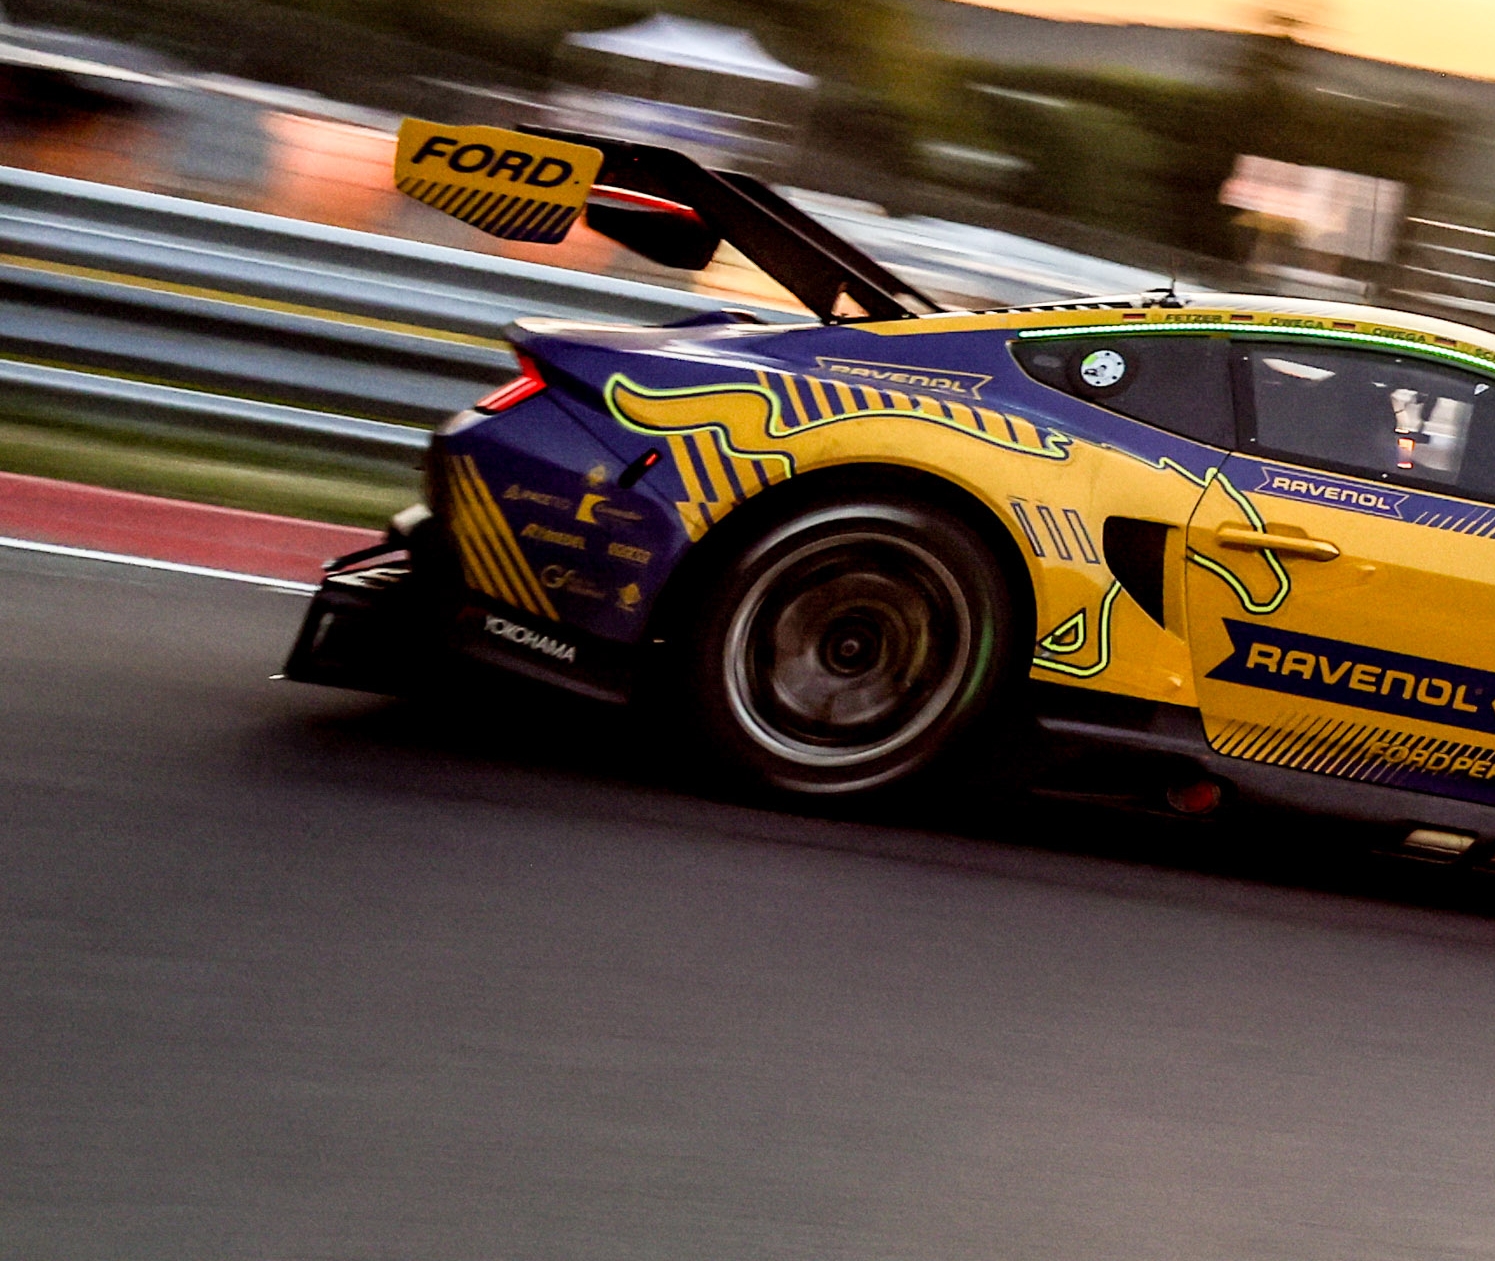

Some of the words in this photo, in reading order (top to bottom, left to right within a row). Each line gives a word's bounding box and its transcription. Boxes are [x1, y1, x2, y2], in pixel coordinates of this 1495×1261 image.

[411, 136, 573, 187] FORD
[1272, 476, 1391, 510] RAVENOL
[484, 614, 576, 663] YOKOHAMA
[1246, 641, 1478, 713] RAVENOL
